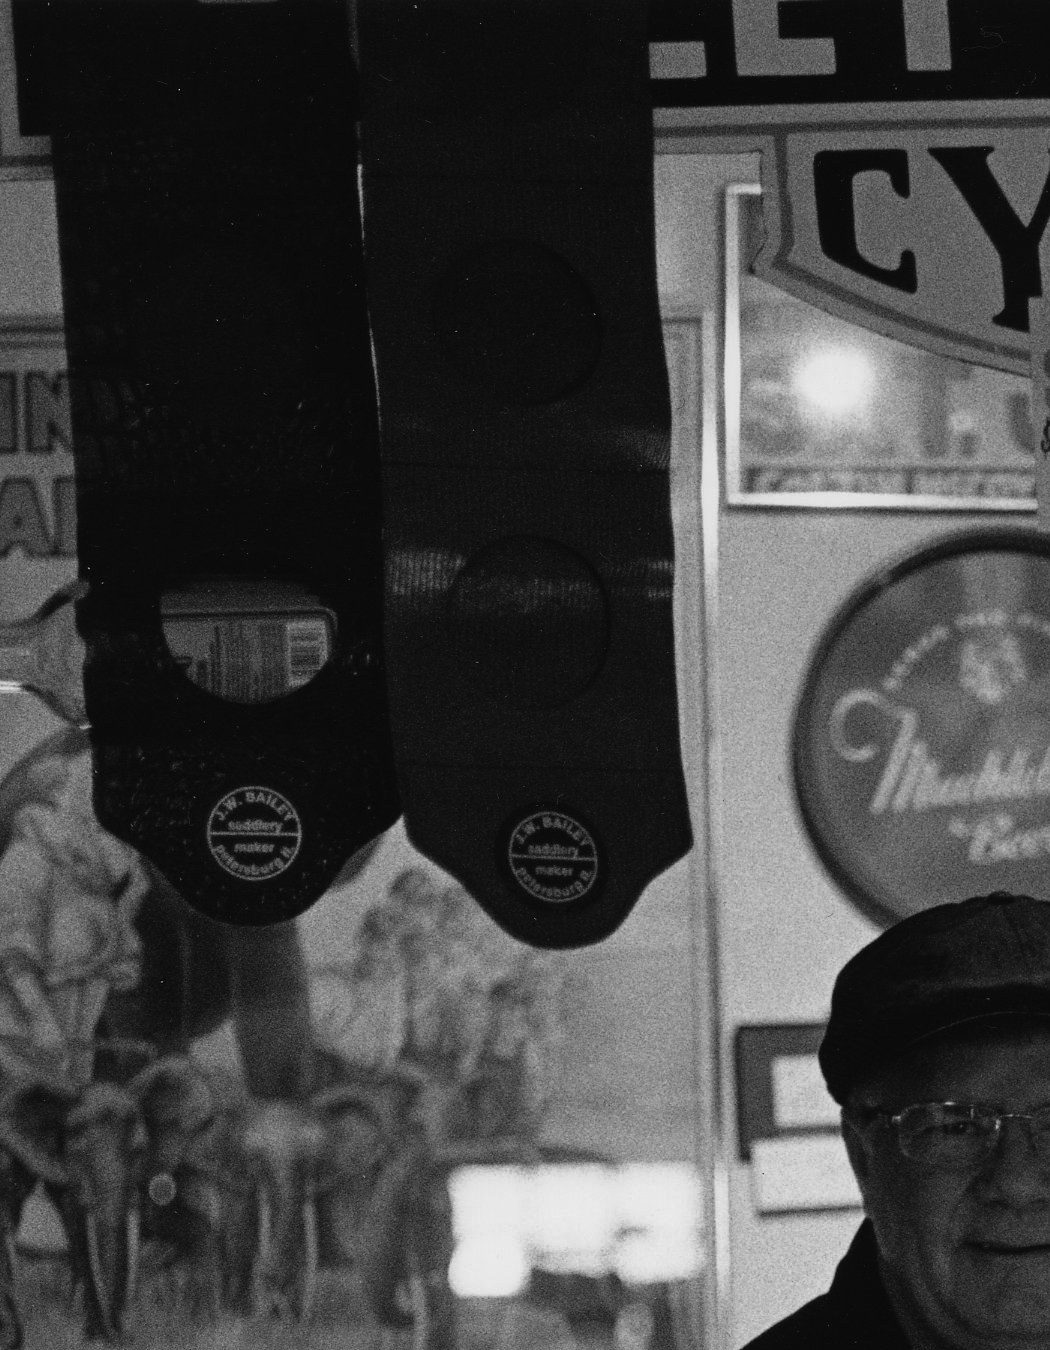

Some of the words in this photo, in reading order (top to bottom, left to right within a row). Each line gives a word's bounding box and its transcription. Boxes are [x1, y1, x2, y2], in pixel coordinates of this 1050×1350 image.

[245, 791, 297, 821] BAILEY
[542, 816, 593, 846] BAILEY
[234, 843, 275, 853] maker
[535, 865, 573, 876] maker
